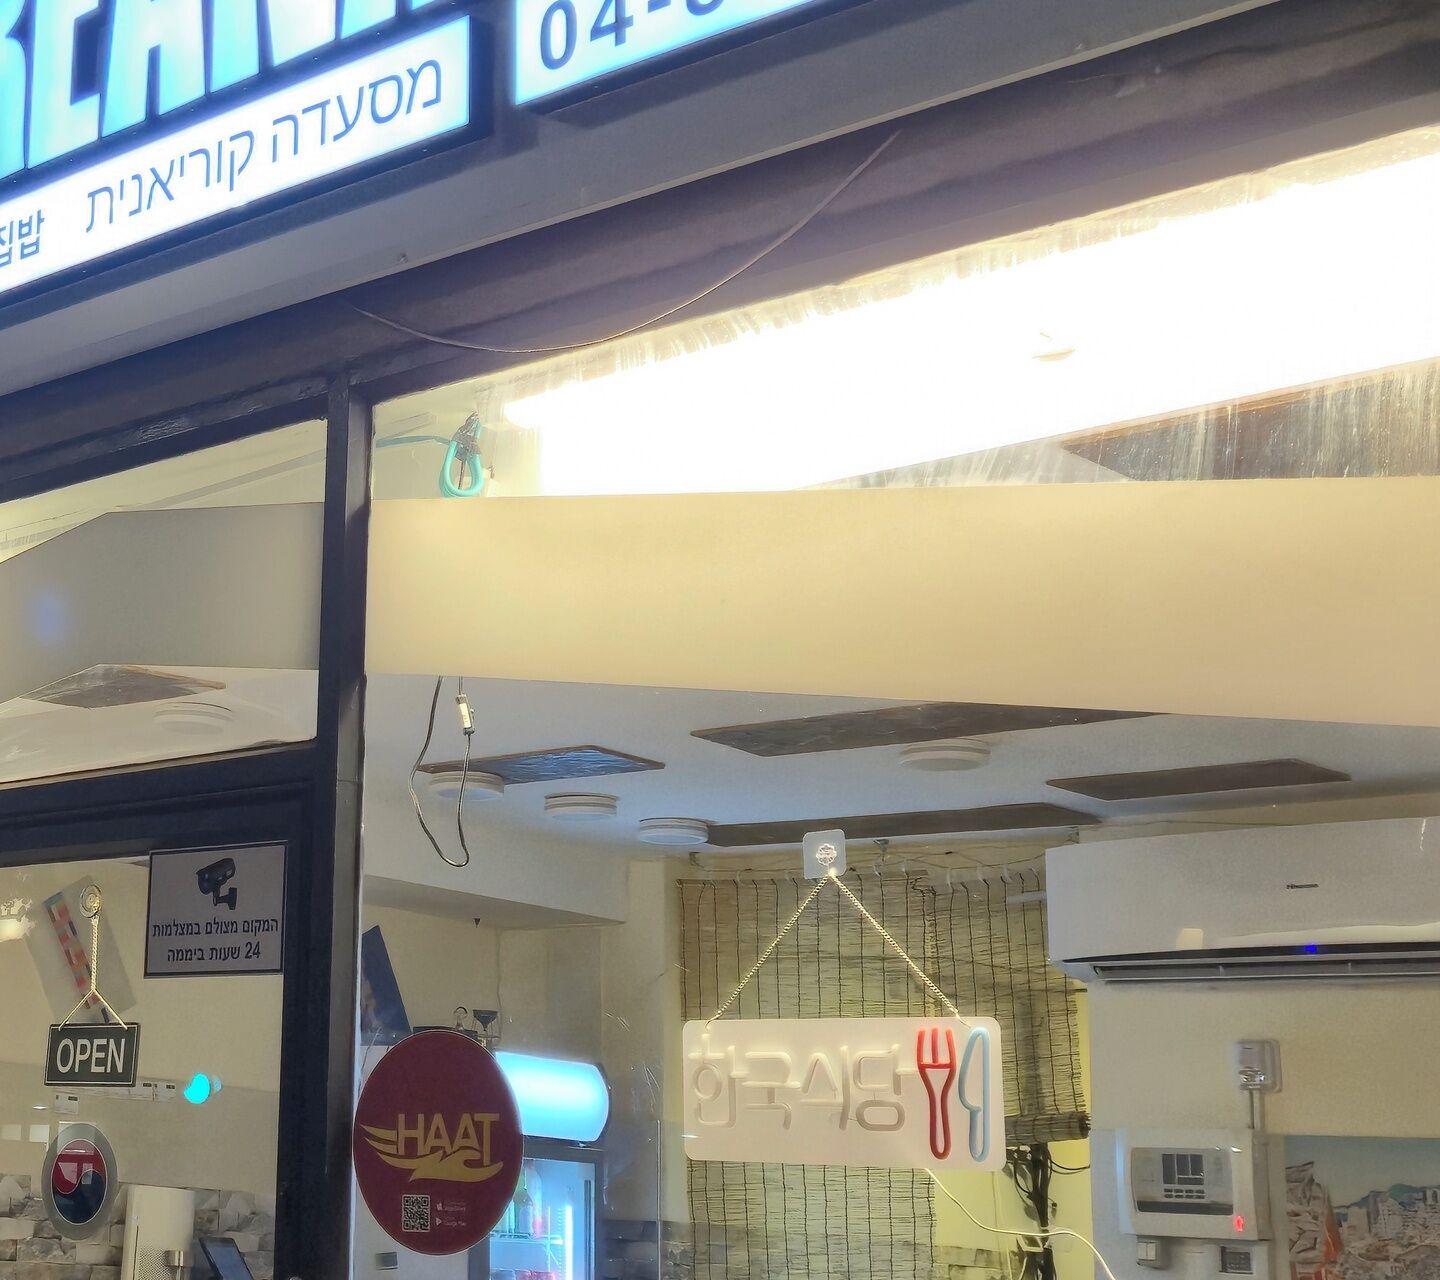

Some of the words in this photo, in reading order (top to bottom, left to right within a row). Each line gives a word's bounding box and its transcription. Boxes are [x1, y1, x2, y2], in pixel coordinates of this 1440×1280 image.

[271, 58, 443, 163] מסעדה
[85, 129, 255, 233] קוריאנית
[152, 918, 201, 937] במצלמות
[205, 917, 238, 935] מצולם
[242, 918, 279, 936] המקום
[167, 948, 205, 962] ביממה
[209, 946, 240, 961] שעות
[245, 941, 260, 959] 24
[56, 1038, 126, 1073] OPEN
[686, 1032, 917, 1132] 한국식당
[397, 1112, 500, 1166] HAAT
